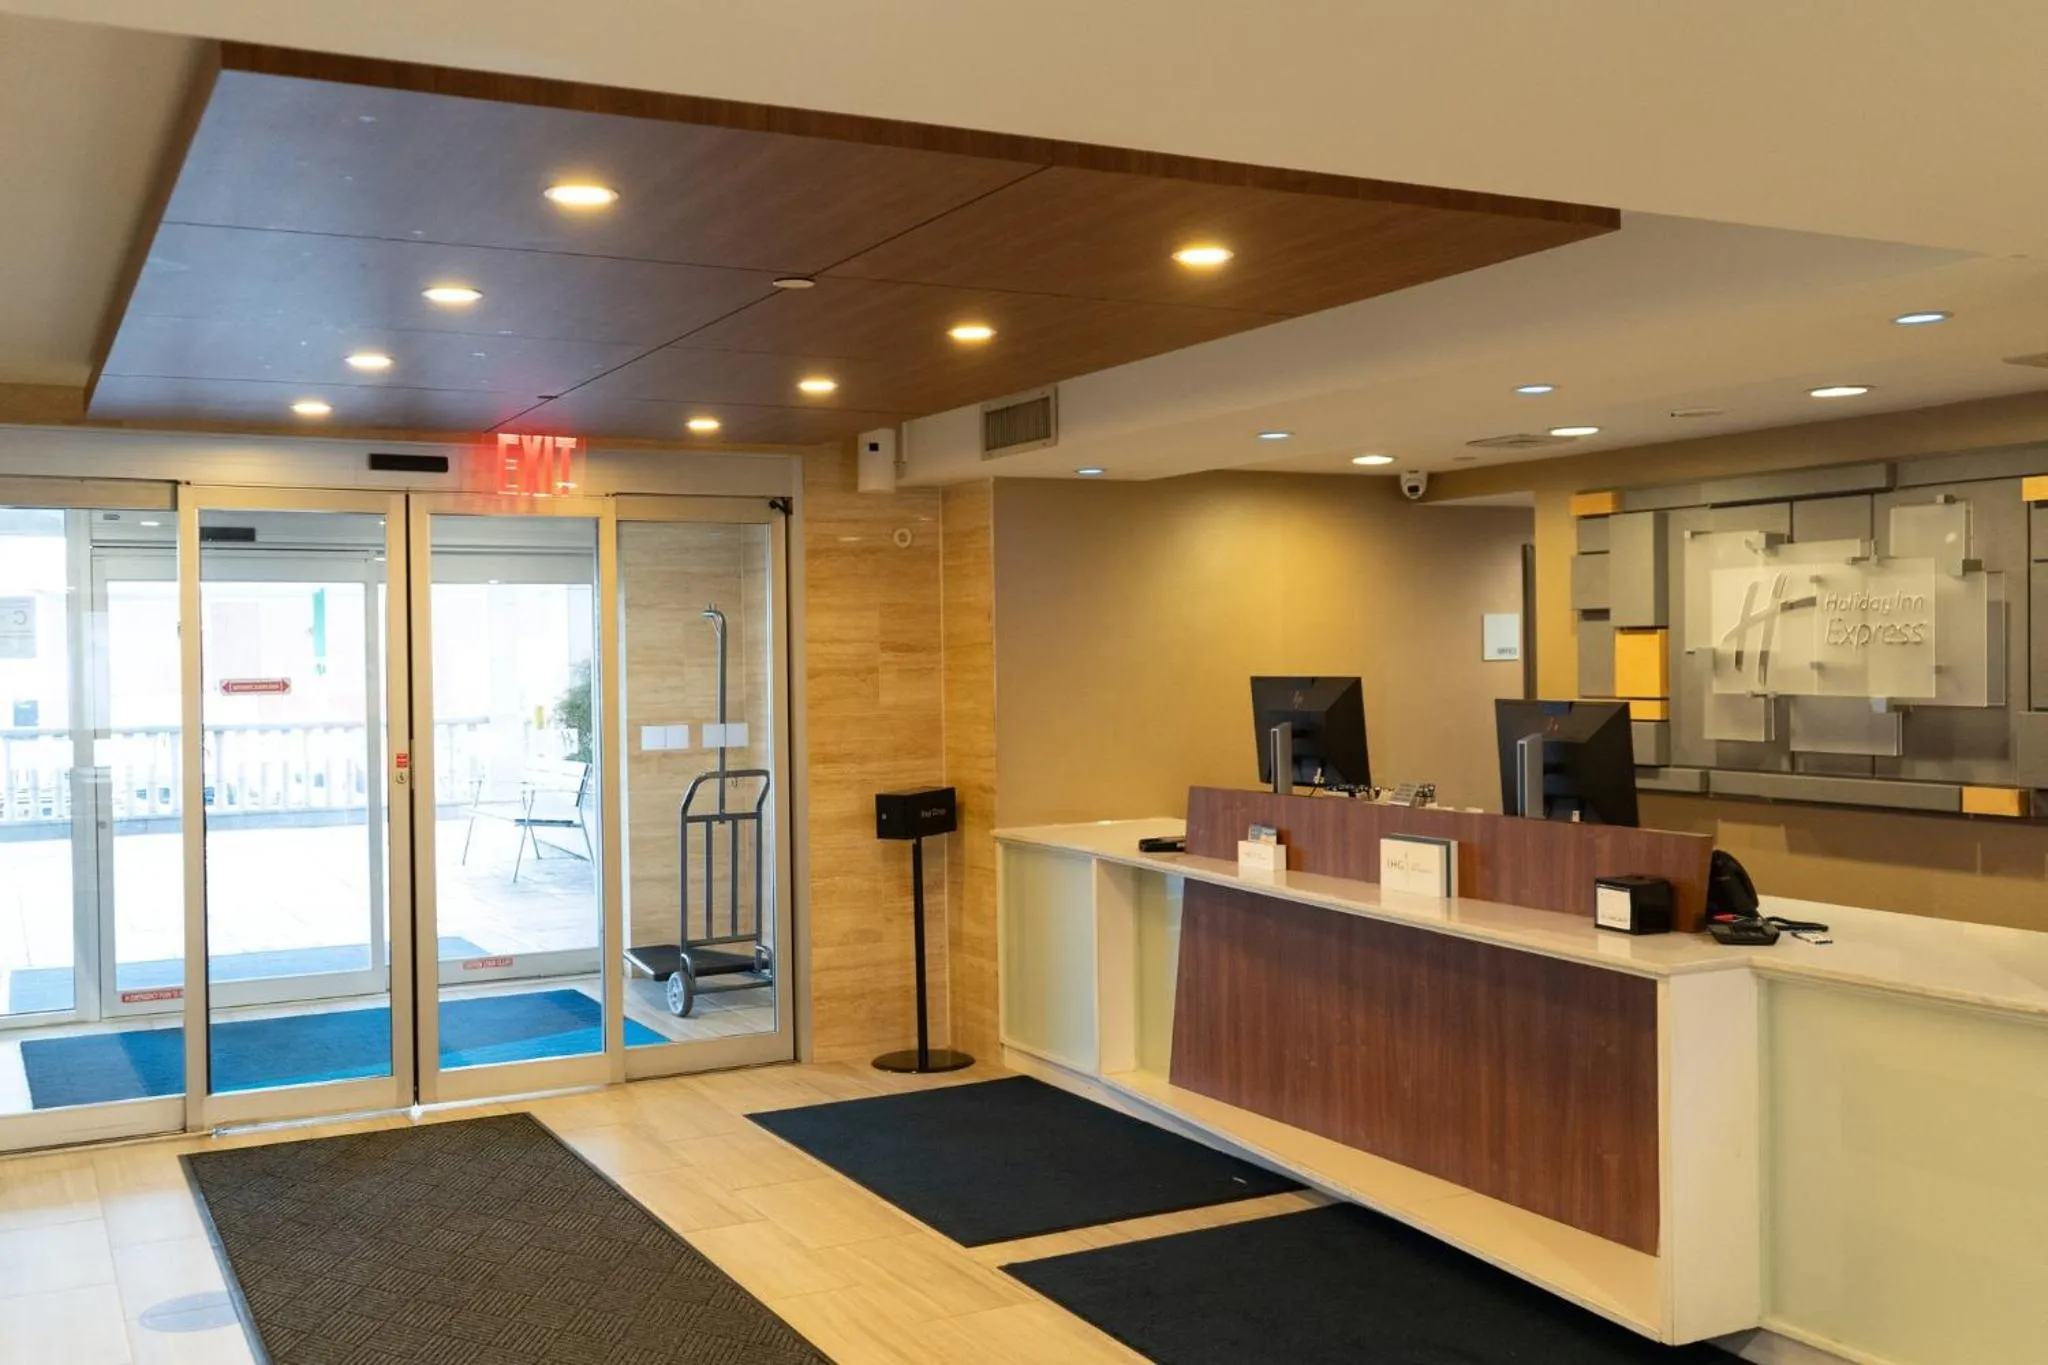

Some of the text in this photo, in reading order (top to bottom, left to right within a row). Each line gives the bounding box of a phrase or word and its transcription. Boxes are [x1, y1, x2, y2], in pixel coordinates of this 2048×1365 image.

[497, 433, 578, 498] EXIT
[1824, 589, 1924, 616] Holiday Inn
[1824, 617, 1926, 655] Express
